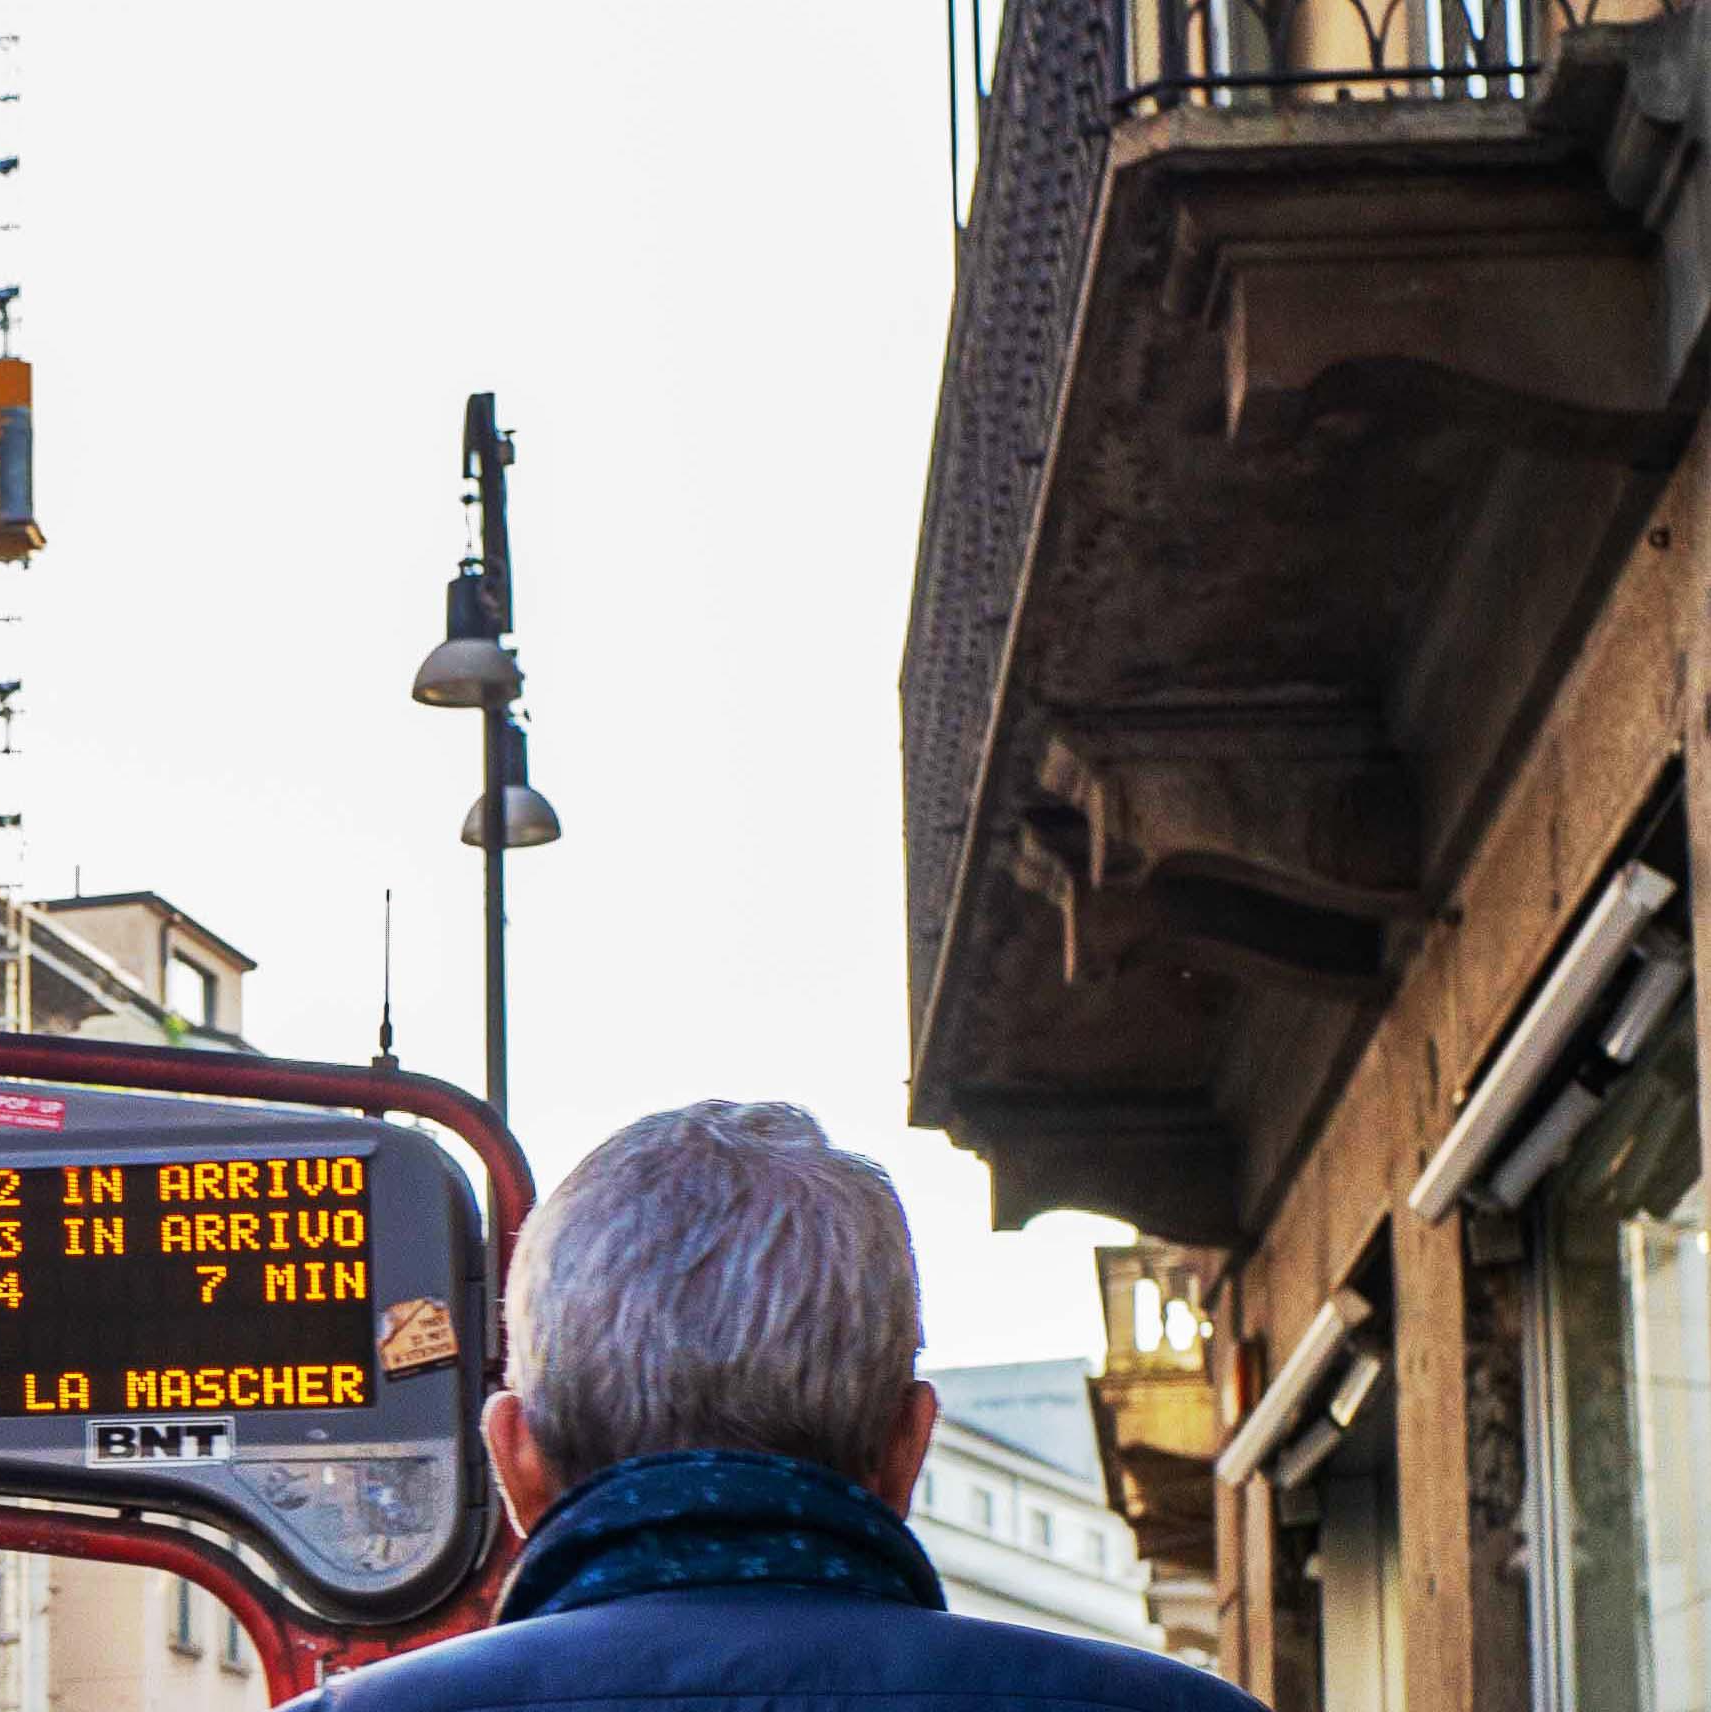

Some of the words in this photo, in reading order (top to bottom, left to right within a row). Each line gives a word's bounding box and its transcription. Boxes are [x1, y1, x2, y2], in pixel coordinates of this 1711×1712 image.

[62, 1166, 124, 1206] IN
[158, 1157, 364, 1202] ARRIVO
[63, 1217, 126, 1256] IN
[160, 1209, 366, 1253] ARRIVO
[195, 1265, 229, 1304] 7
[264, 1261, 367, 1302] MIN
[24, 1371, 91, 1411] LA
[126, 1363, 365, 1410] MASCHER
[97, 1424, 225, 1459] BNT
